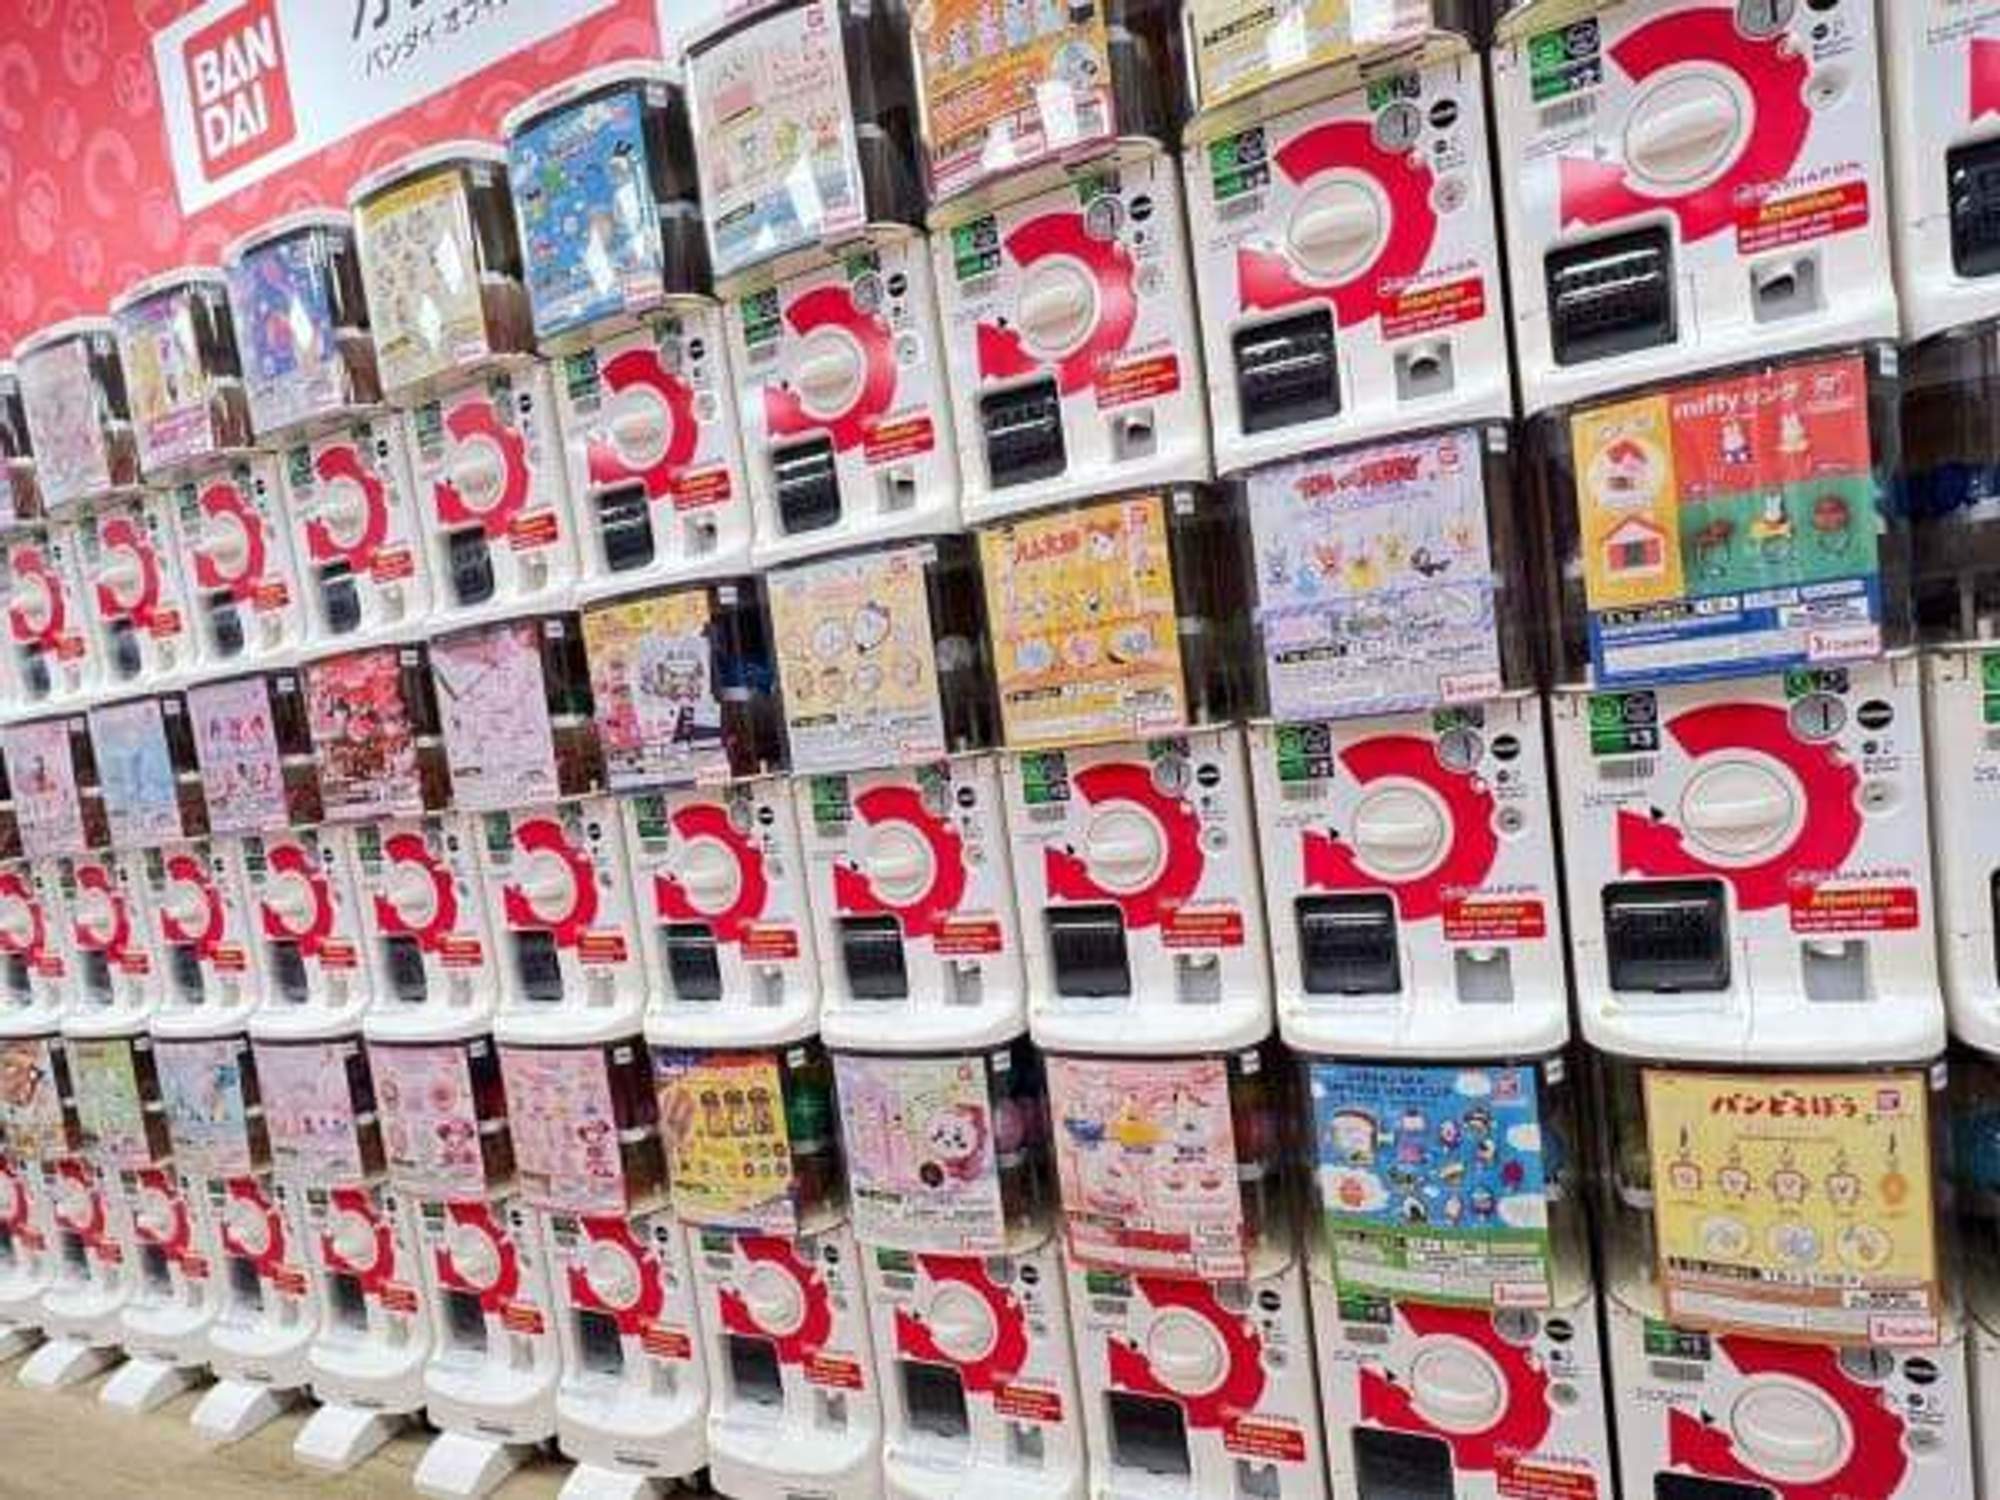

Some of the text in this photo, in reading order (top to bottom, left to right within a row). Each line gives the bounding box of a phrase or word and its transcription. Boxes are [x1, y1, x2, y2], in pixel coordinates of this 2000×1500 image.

[192, 17, 277, 105] BAN
[203, 81, 268, 159] DAI
[1673, 392, 1738, 420] miffy
